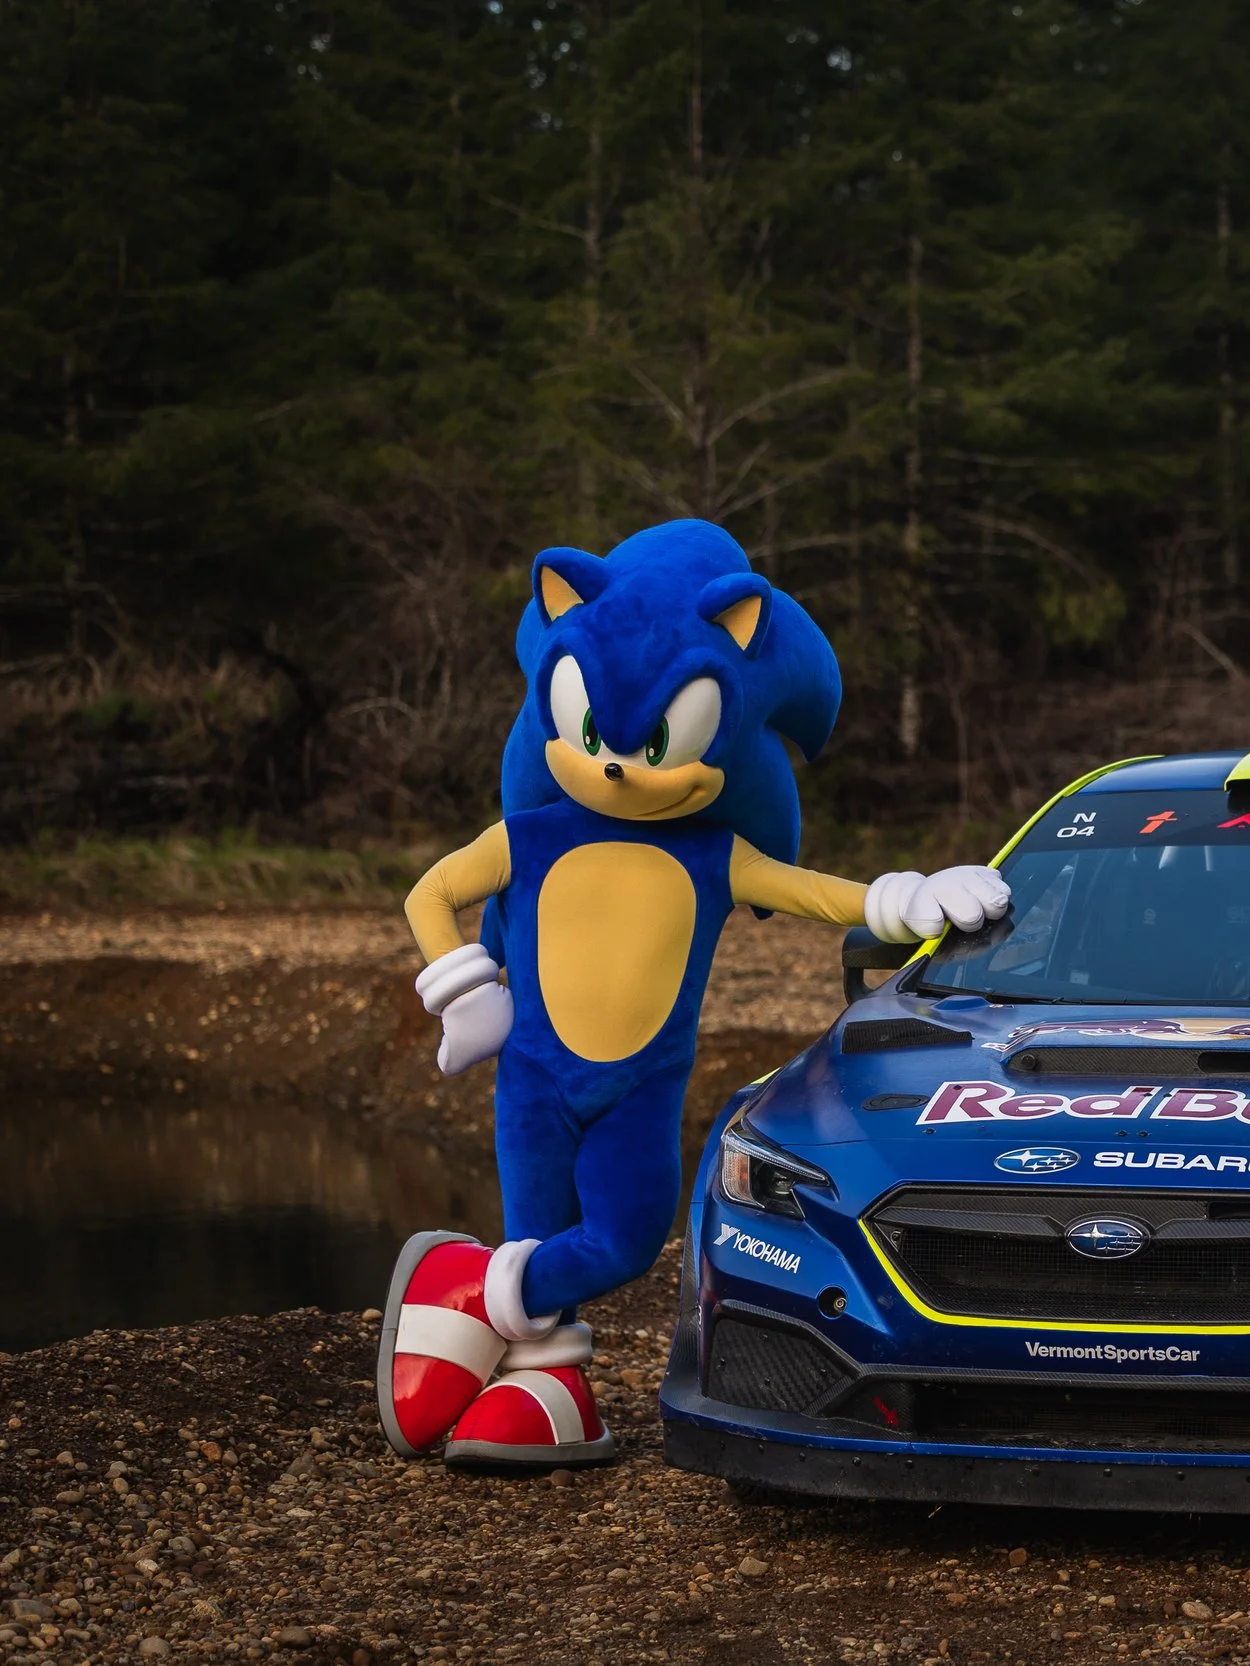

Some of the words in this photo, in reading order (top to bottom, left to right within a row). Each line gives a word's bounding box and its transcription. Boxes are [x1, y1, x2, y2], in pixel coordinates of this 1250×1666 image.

[1072, 811, 1097, 824] N
[1056, 825, 1096, 838] 04
[915, 1080, 1163, 1126] Red
[732, 1231, 802, 1275] YOKOHAMA
[1025, 1341, 1201, 1363] VermontSportsCar
